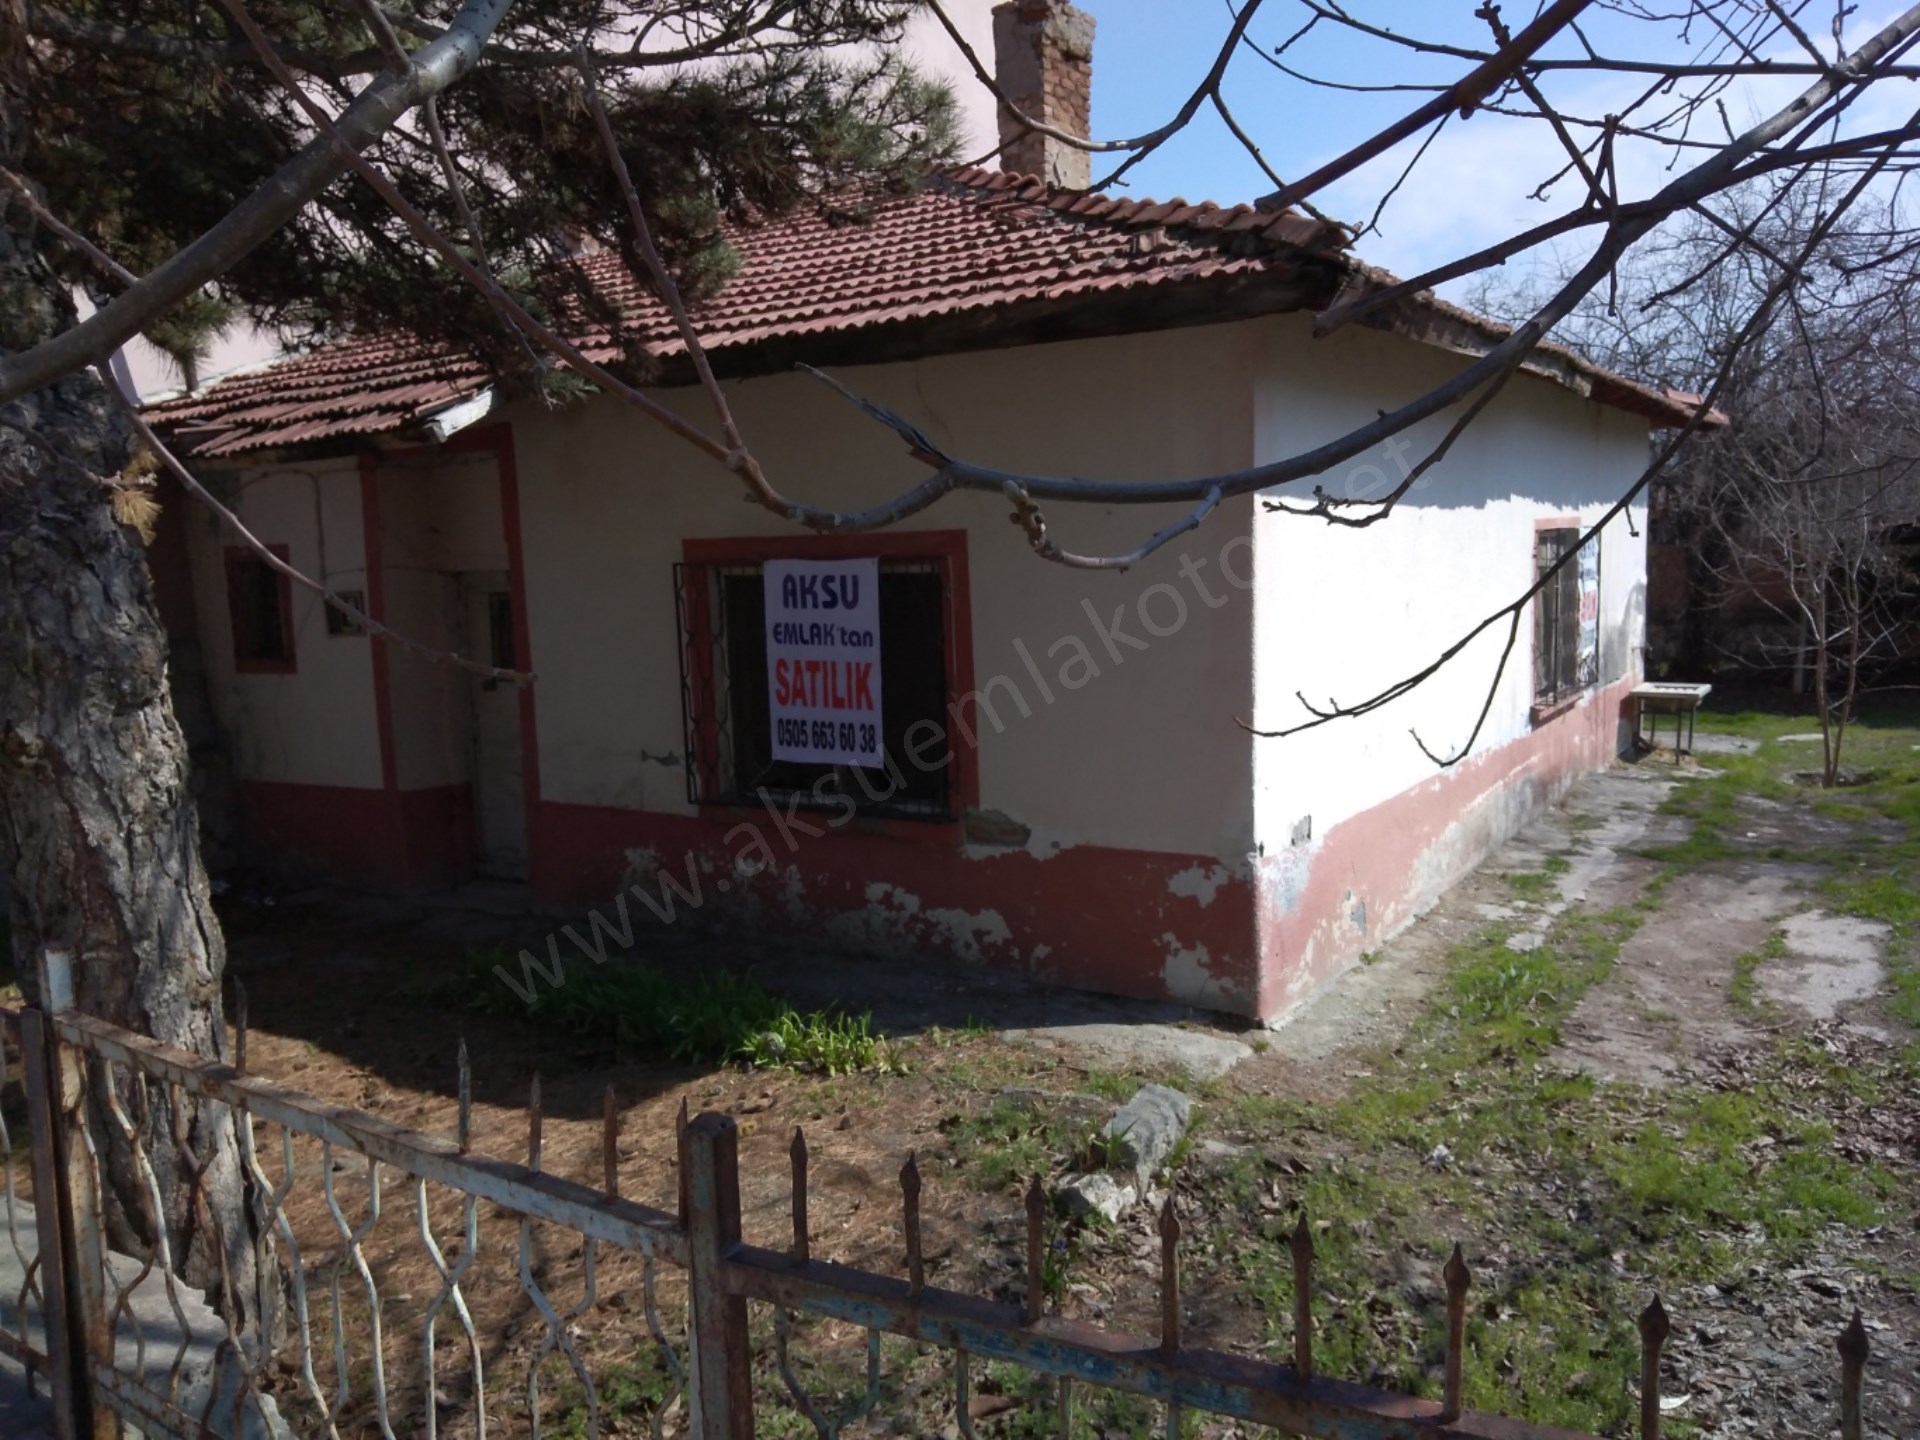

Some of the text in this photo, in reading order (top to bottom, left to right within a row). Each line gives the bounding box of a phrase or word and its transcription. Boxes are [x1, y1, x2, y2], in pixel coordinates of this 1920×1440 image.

[782, 573, 859, 610] AKSU
[775, 657, 875, 711] SATILIK
[777, 718, 876, 754] 0505 663 60 38
